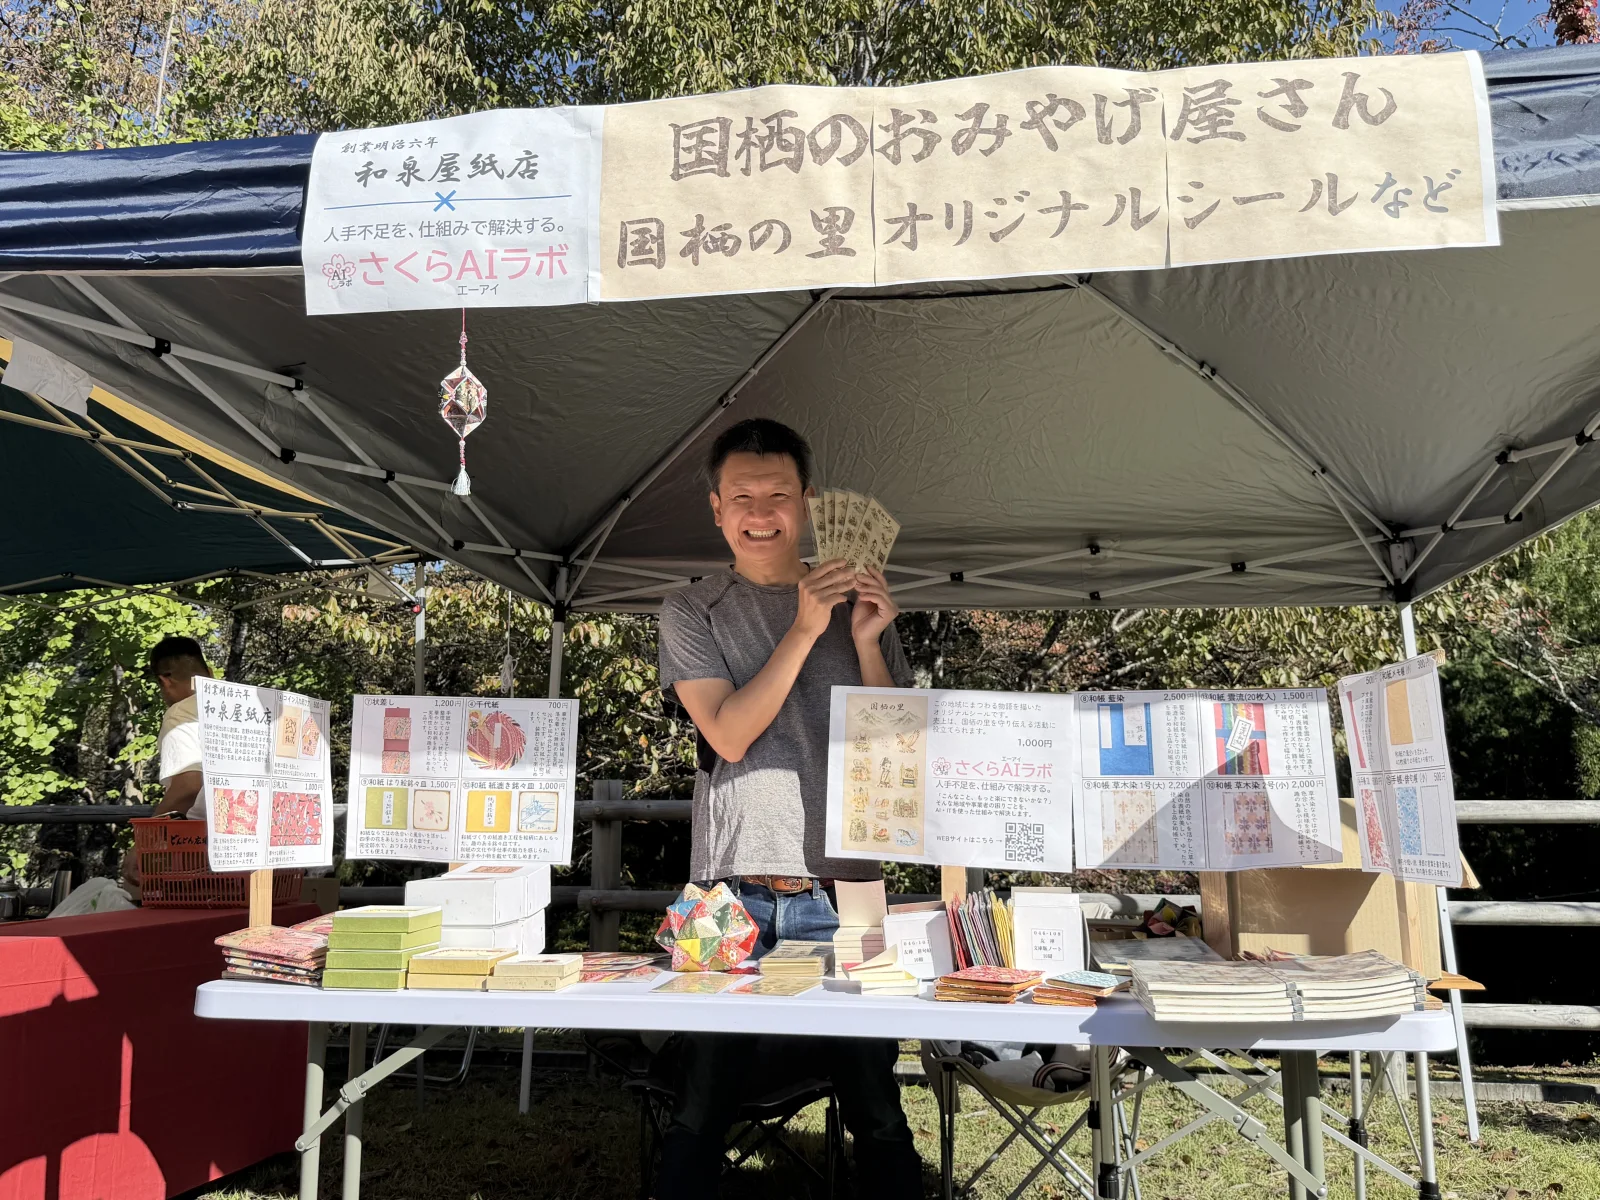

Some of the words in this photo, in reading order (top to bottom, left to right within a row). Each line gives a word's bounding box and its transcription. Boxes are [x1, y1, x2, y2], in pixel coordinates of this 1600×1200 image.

[670, 70, 1398, 182] 国栖のおみやげ屋さん
[341, 136, 438, 154] 創業明治六年
[354, 150, 539, 188] 和泉屋紙店
[323, 217, 565, 243] 人手不足を、仕組みで解決する。
[359, 244, 569, 285] さくらAIラボ
[457, 284, 499, 296] エーアイ
[204, 683, 250, 700] 創業明治六年
[1108, 694, 1125, 702] 藍染
[1163, 693, 1194, 701] 2,500円
[1282, 692, 1314, 700] 1,500円
[870, 702, 905, 711] 国栖の里
[204, 700, 272, 726] 和泉屋紙店
[1017, 738, 1053, 748] 1,000円
[955, 760, 1054, 778] さくらAIラボ
[430, 780, 456, 788] 1,500円
[538, 782, 565, 790] 1,000円
[935, 780, 1051, 793] 人手不足を、仕組みで解決する。
[1112, 781, 1138, 790] 草木染
[1168, 781, 1200, 790] 2,200円
[1234, 781, 1260, 790] 草木染
[1292, 780, 1324, 788] 2,000円
